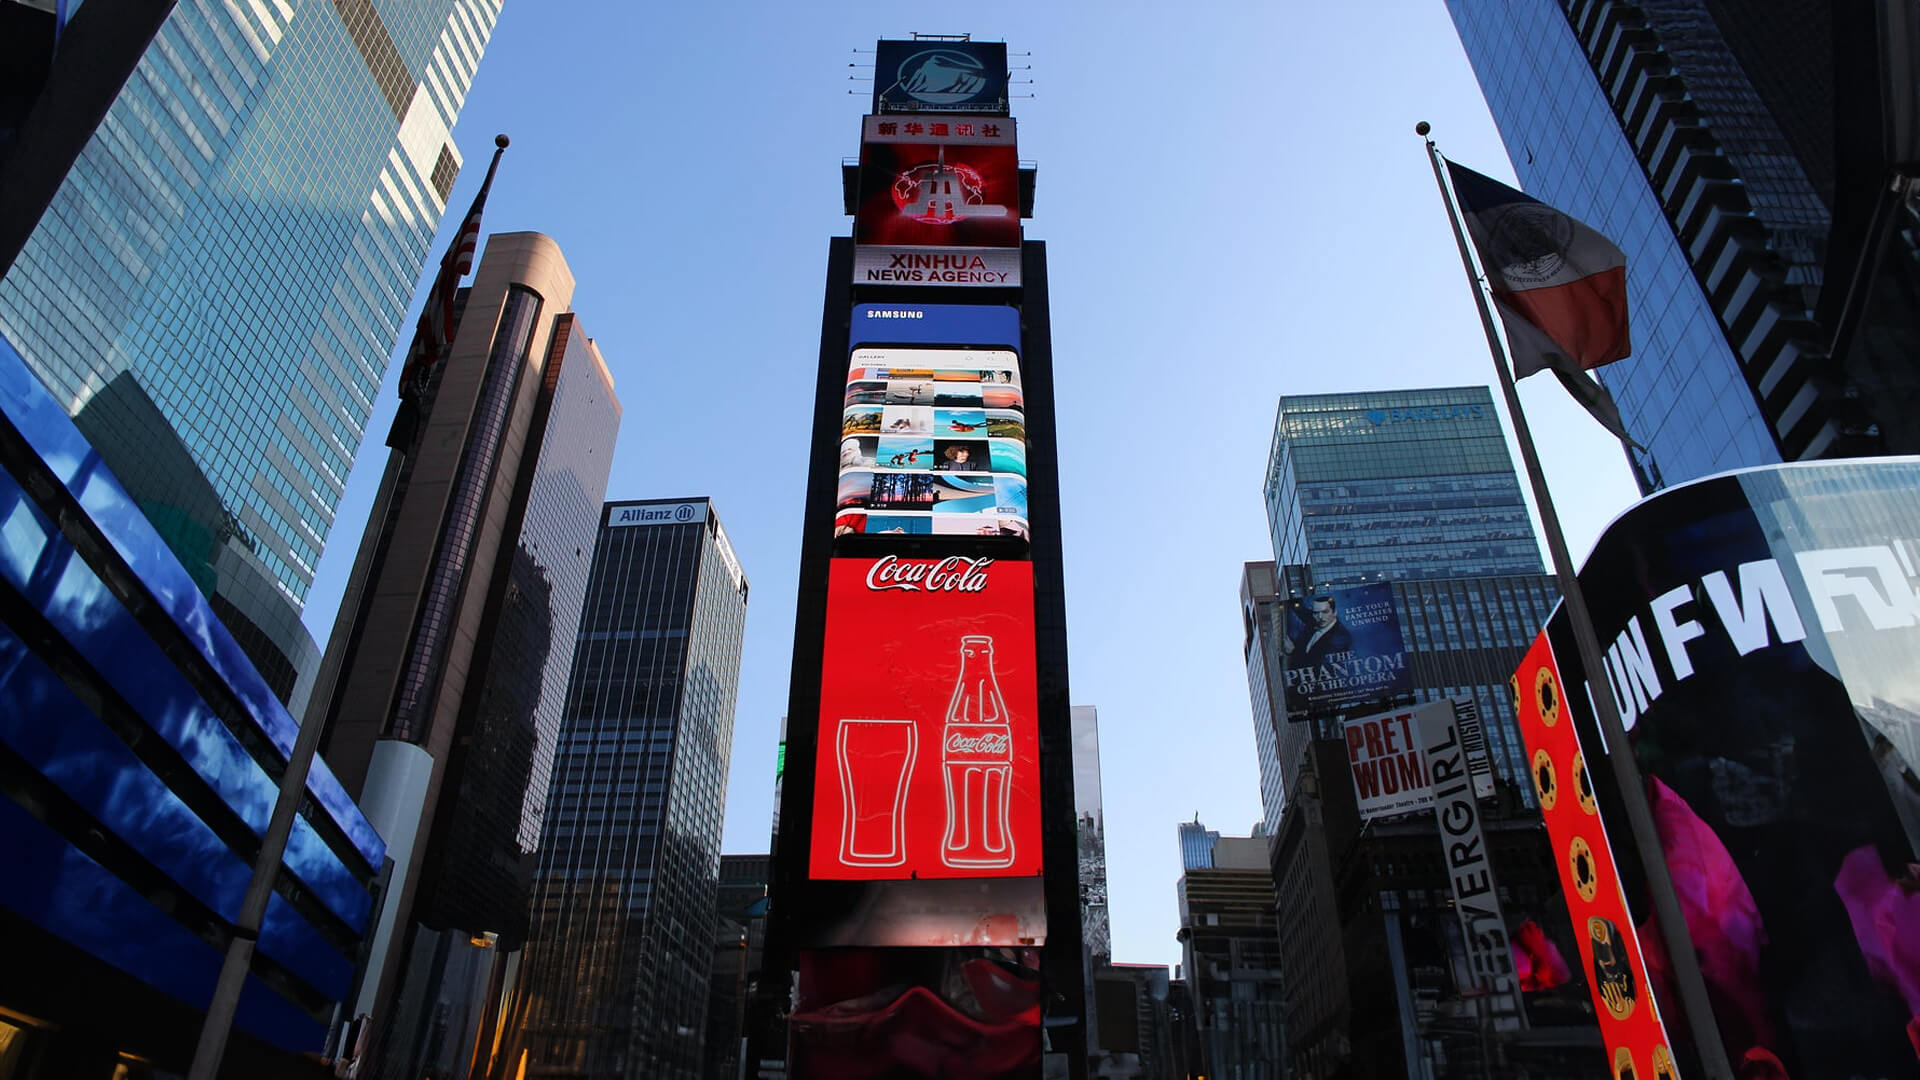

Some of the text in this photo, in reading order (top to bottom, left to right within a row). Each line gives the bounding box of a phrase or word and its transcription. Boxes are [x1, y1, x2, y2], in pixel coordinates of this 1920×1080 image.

[878, 122, 1001, 137] 新华通讯社
[891, 253, 986, 270] XINHUA
[867, 269, 1009, 283] NEWS AGENCY
[867, 310, 923, 319] SAMSUNG
[1389, 405, 1484, 423] BARCLAYS
[619, 509, 673, 521] Allianz
[866, 554, 995, 592] Coca-Cola
[1345, 602, 1390, 614] LET YOUR
[1345, 608, 1393, 621] FANTASIES
[1351, 616, 1389, 626] UNWIND
[1325, 651, 1357, 663] THE
[1284, 652, 1405, 687] PHANTOM
[1297, 682, 1316, 695] OF
[1317, 677, 1348, 692] THE
[1350, 671, 1397, 686] OPERA
[1346, 713, 1417, 762] PRET
[1454, 700, 1489, 777] THE MUSICAL
